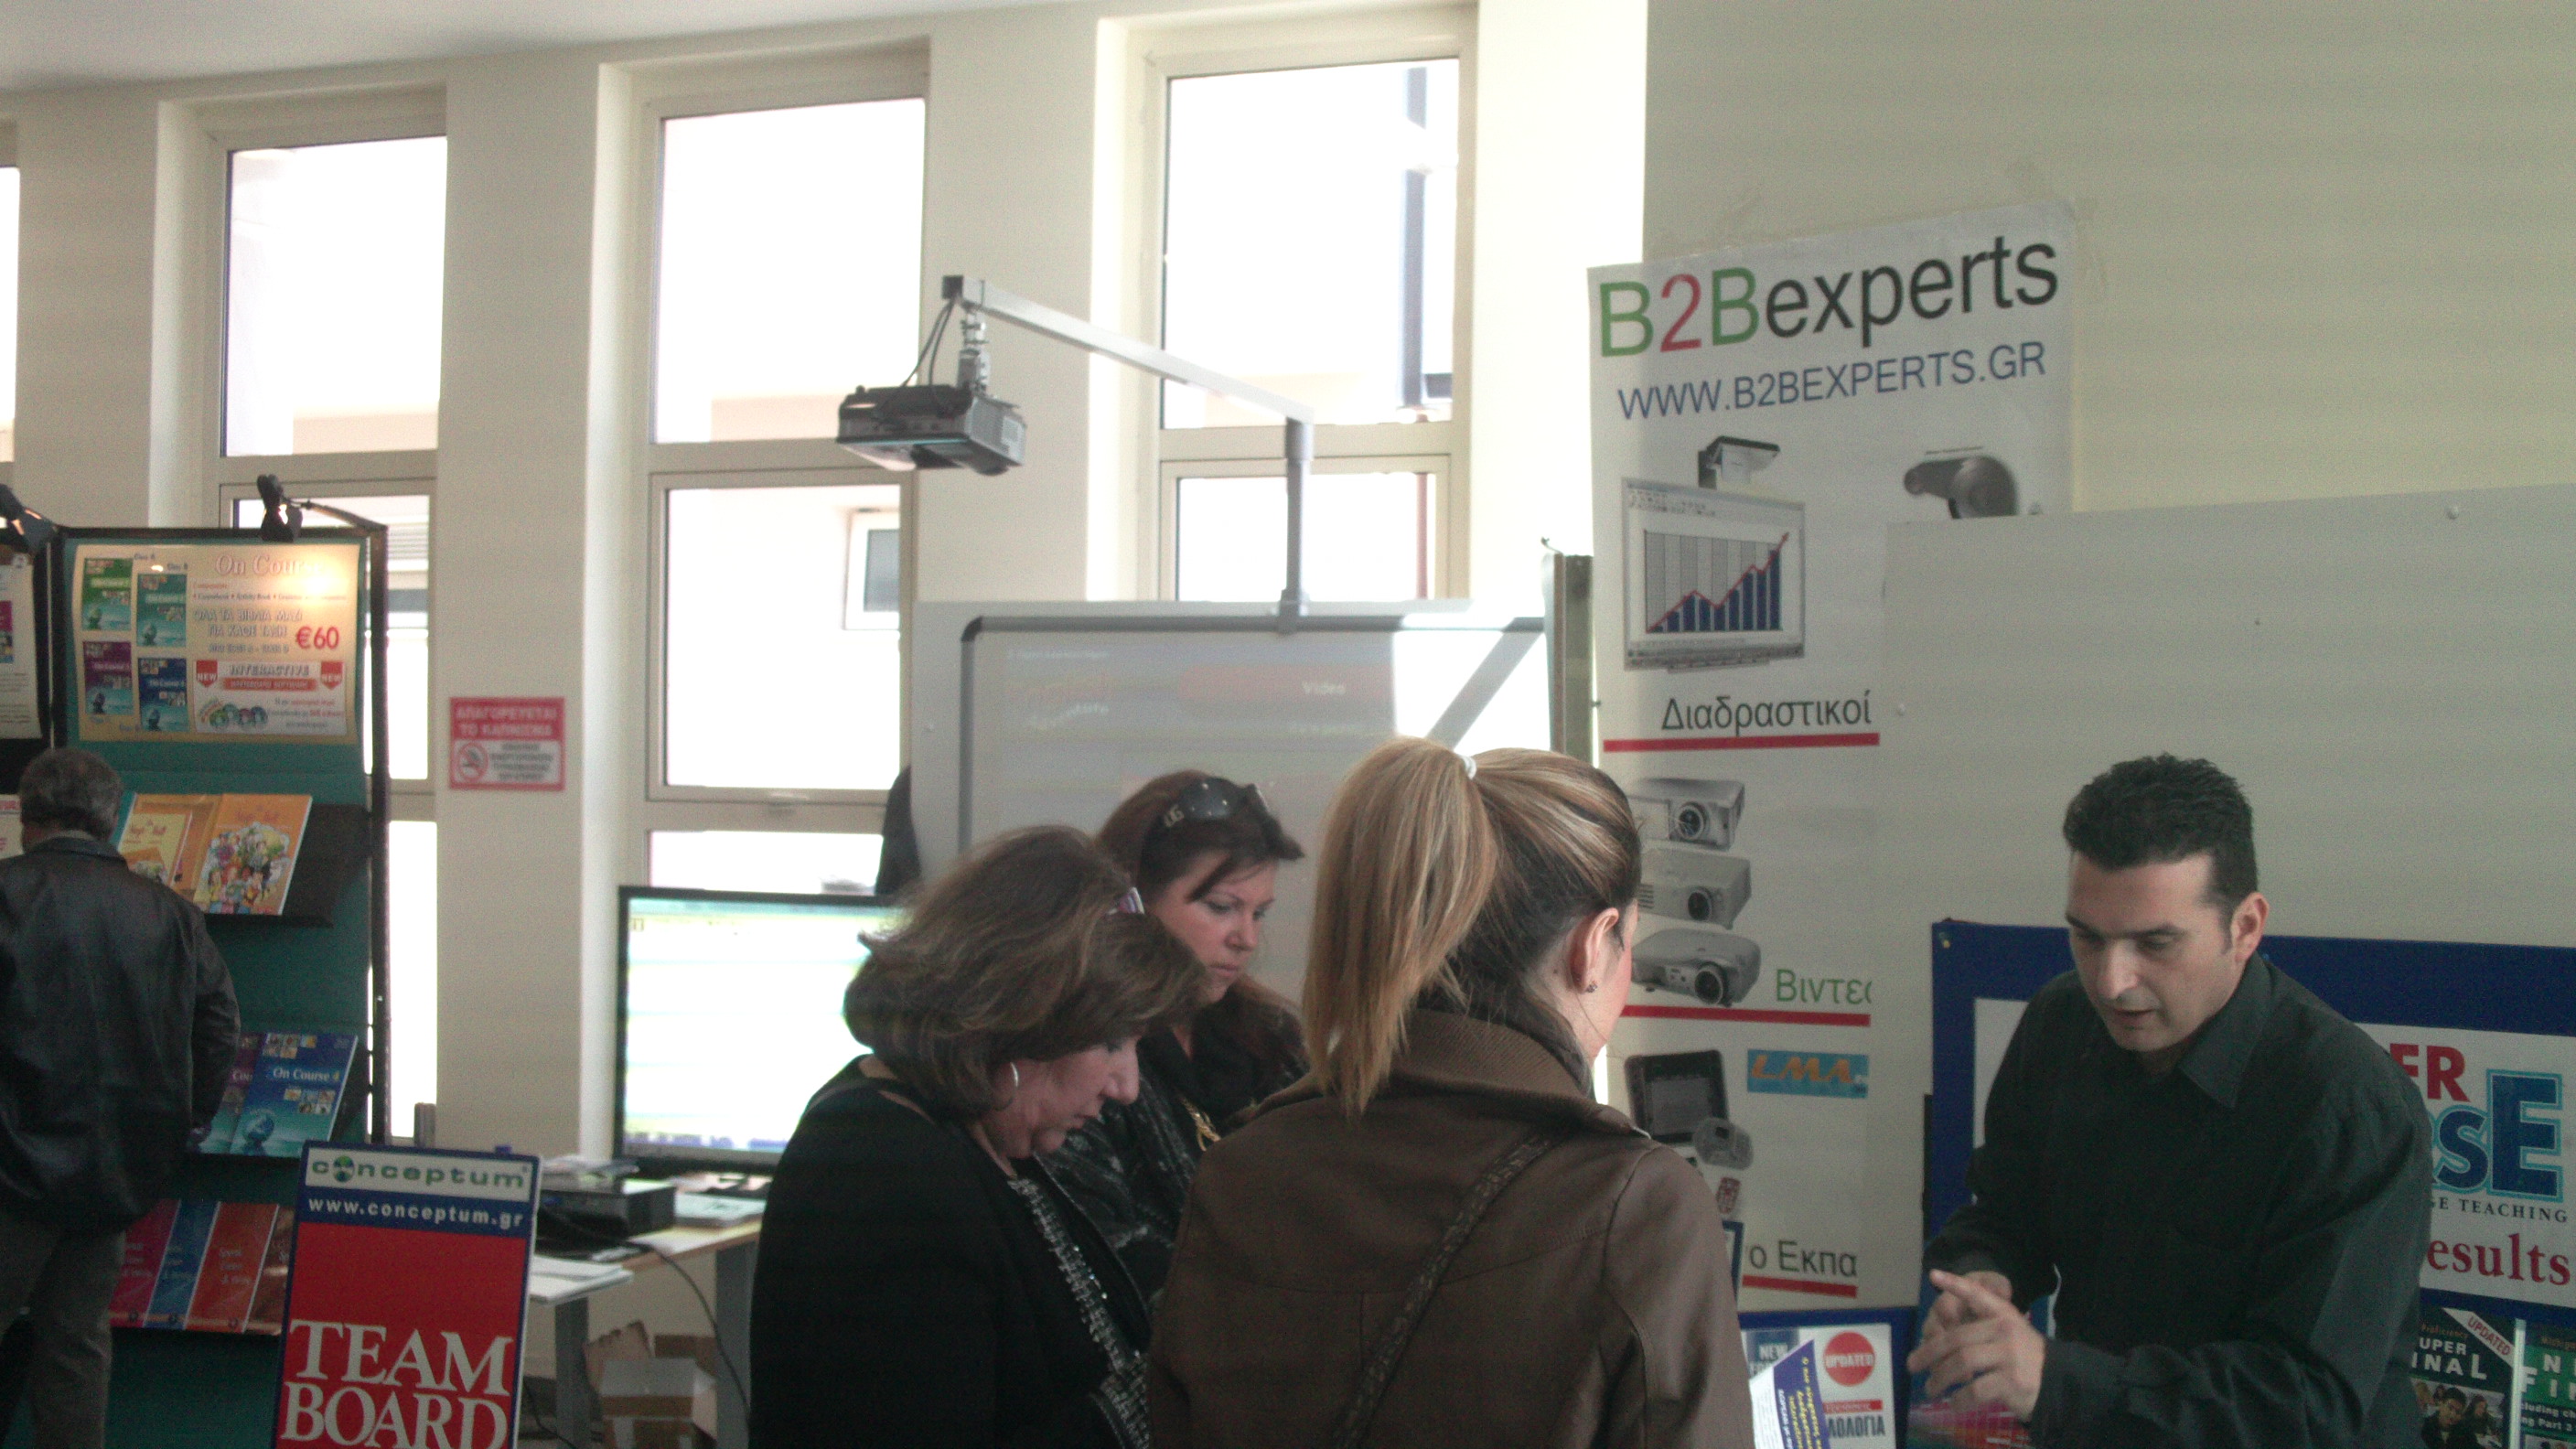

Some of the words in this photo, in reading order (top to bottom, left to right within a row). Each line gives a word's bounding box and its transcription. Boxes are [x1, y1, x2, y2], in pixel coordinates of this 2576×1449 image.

[1600, 236, 2058, 358] B2Bexperts
[1617, 341, 2046, 420] WWW.B2BEXPERTS.GR
[215, 553, 246, 575] On
[295, 626, 340, 650] €60
[198, 673, 217, 682] NEW
[1661, 690, 1872, 737] Διαδραστικοί
[273, 1068, 290, 1079] On
[293, 1068, 331, 1082] Course
[333, 1070, 340, 1082] 4
[308, 1196, 526, 1230] www.conceptum.gr
[2458, 1198, 2568, 1223] TEACHING
[2427, 1232, 2571, 1286] esults
[289, 1318, 514, 1396] TEAM
[2467, 1315, 2511, 1357] UPDATED
[281, 1380, 509, 1449] BOARD
